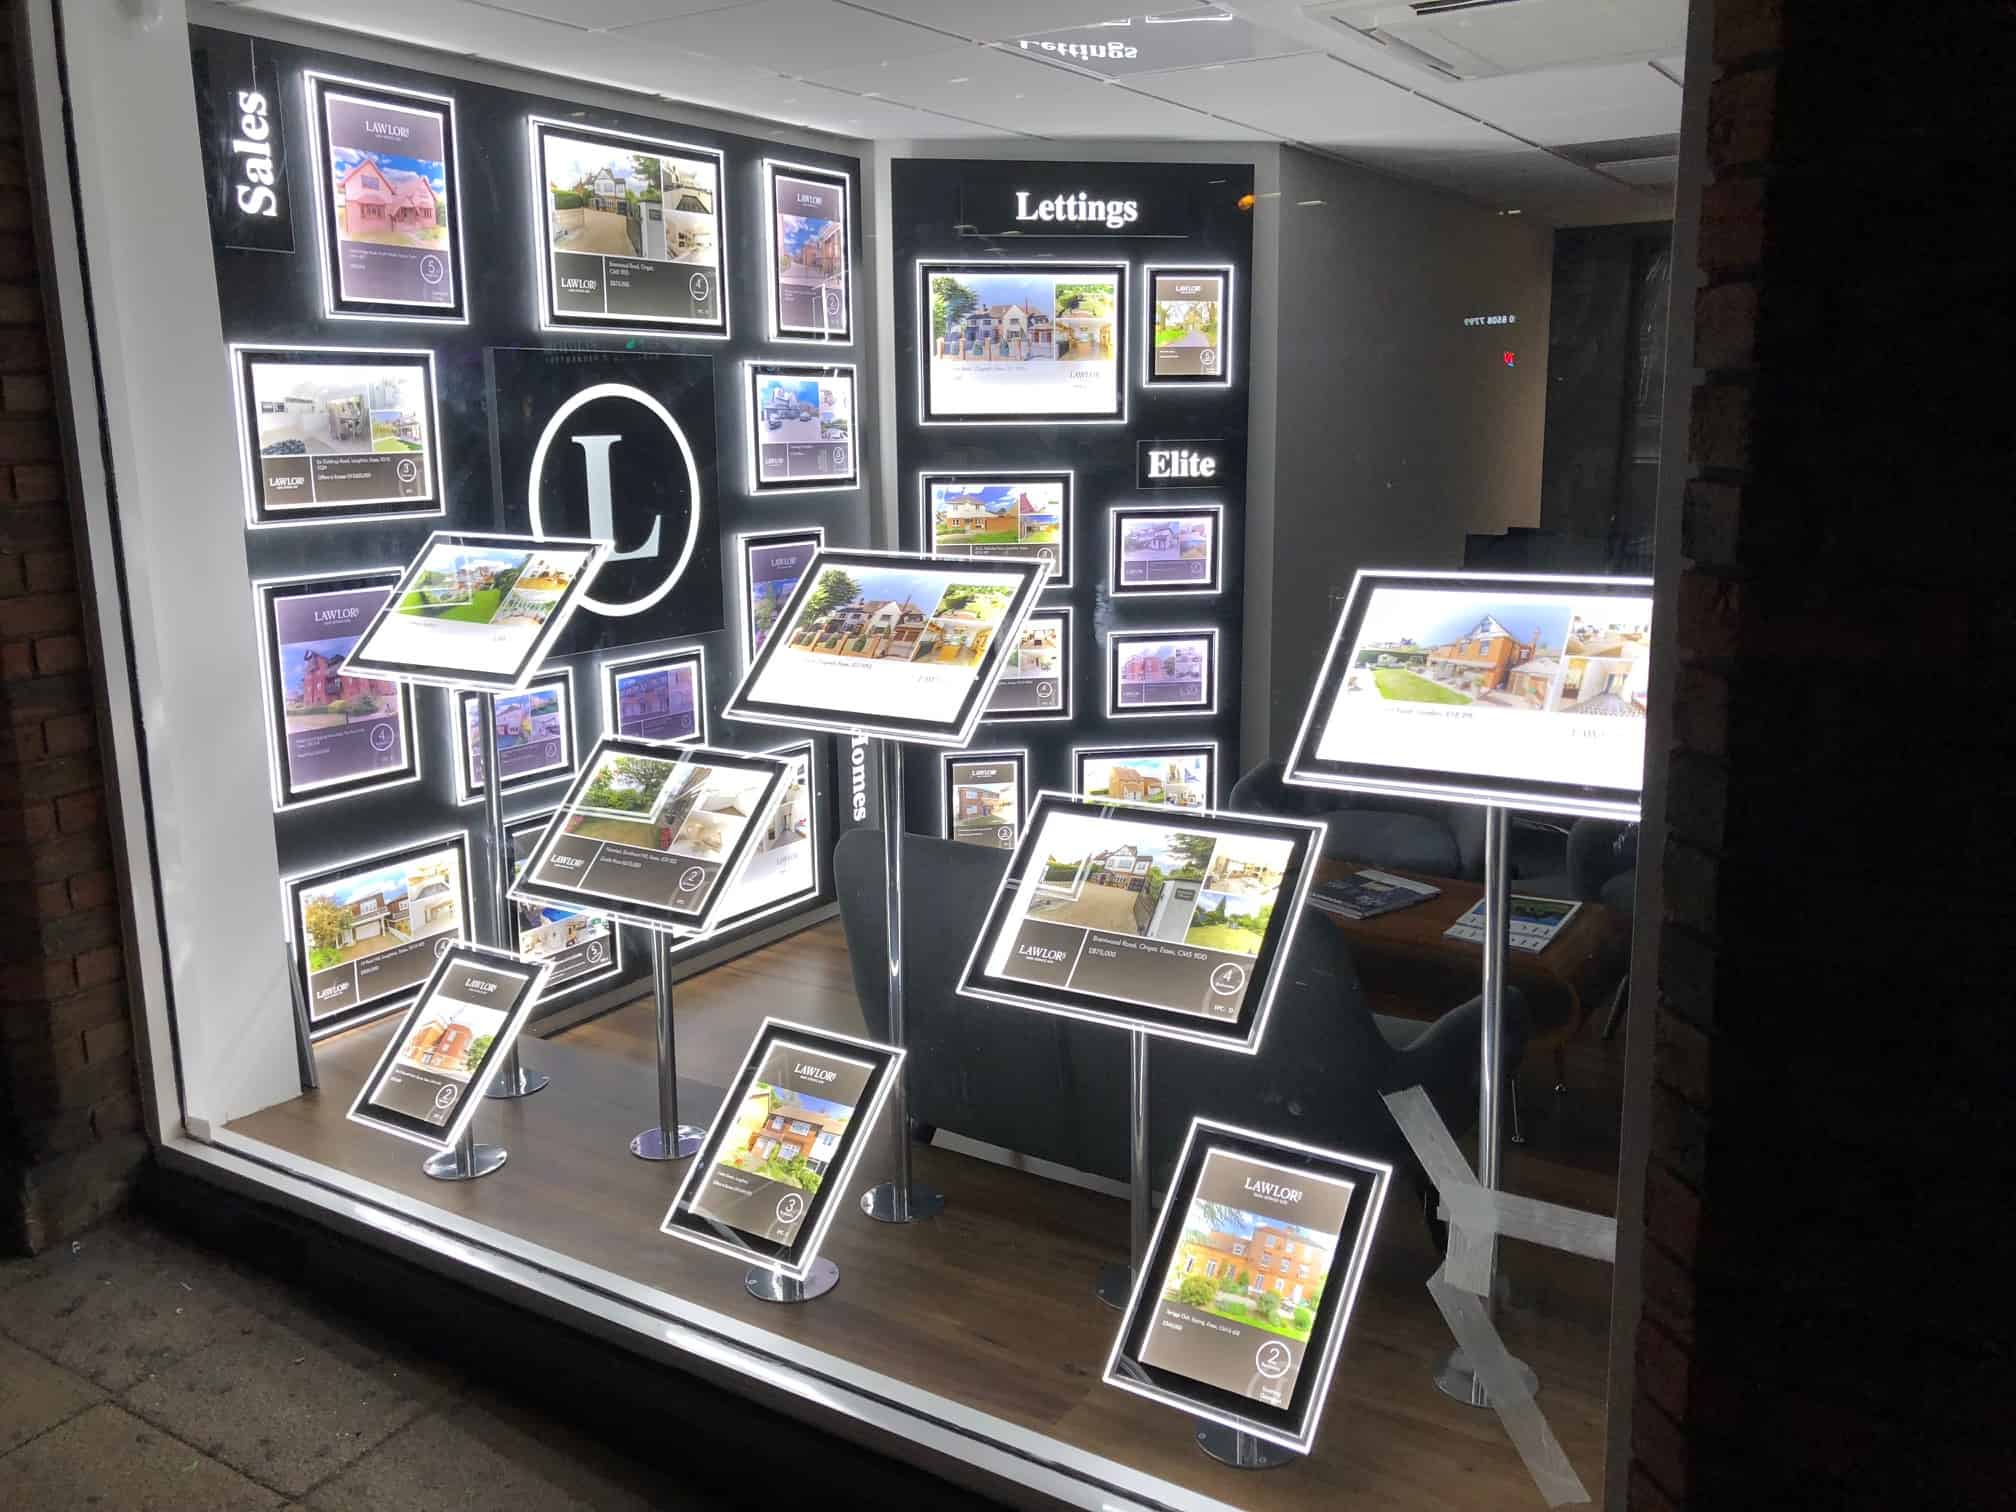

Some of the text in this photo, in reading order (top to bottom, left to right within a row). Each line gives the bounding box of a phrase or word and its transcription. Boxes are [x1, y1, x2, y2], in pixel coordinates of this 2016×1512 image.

[233, 91, 278, 216] Sales
[1015, 191, 1138, 229] Lettings
[1147, 449, 1216, 478] Elite
[1222, 969, 1233, 983] 4
[785, 1199, 797, 1213] 3
[1267, 1347, 1281, 1365] 2
